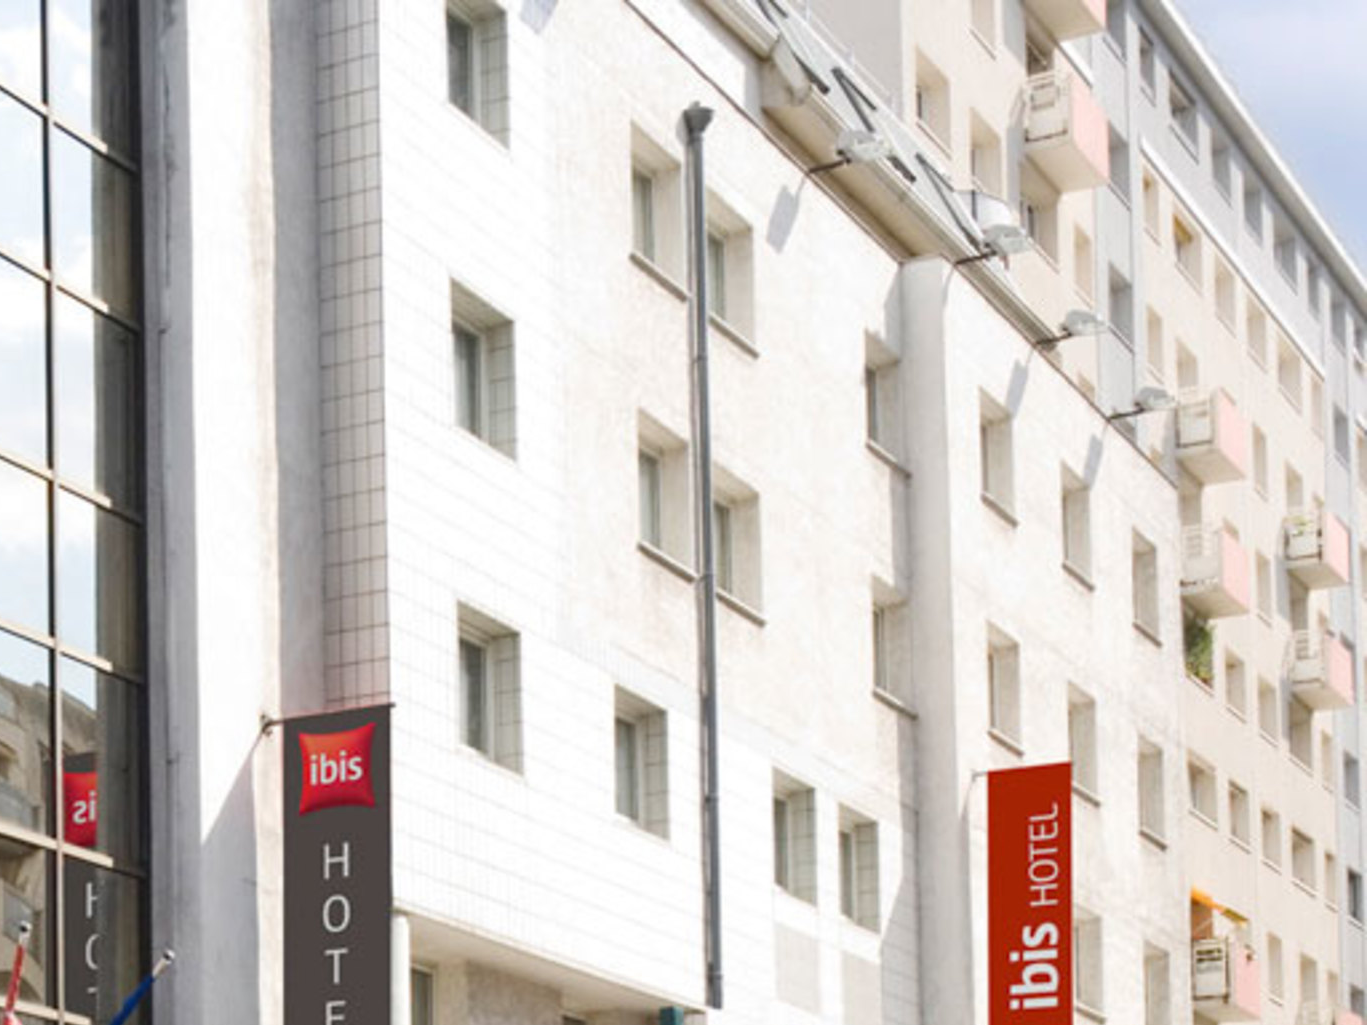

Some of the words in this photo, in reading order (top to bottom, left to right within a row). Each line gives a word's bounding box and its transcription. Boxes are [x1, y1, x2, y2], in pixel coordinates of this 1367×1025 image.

[309, 750, 363, 786] ibis
[1029, 800, 1059, 908] HOTEL
[1009, 922, 1059, 1010] ibis
